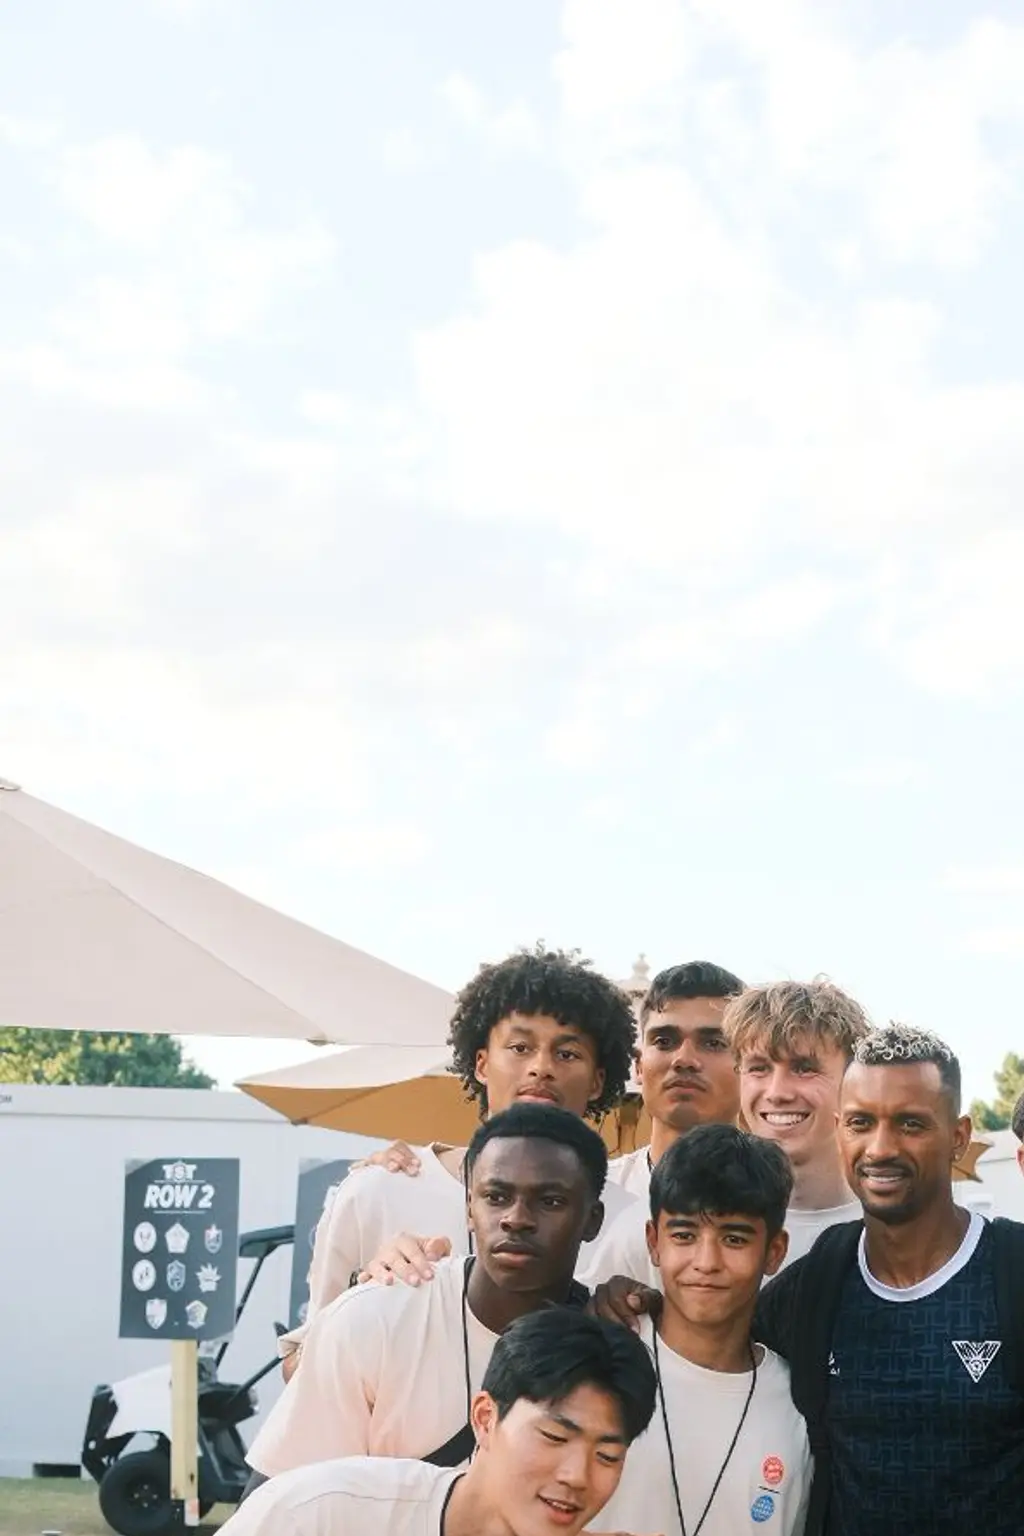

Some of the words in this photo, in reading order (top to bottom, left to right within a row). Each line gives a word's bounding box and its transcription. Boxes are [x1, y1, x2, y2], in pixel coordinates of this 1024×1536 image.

[162, 1161, 197, 1182] TST
[144, 1185, 198, 1208] ROW
[198, 1184, 215, 1208] 2
